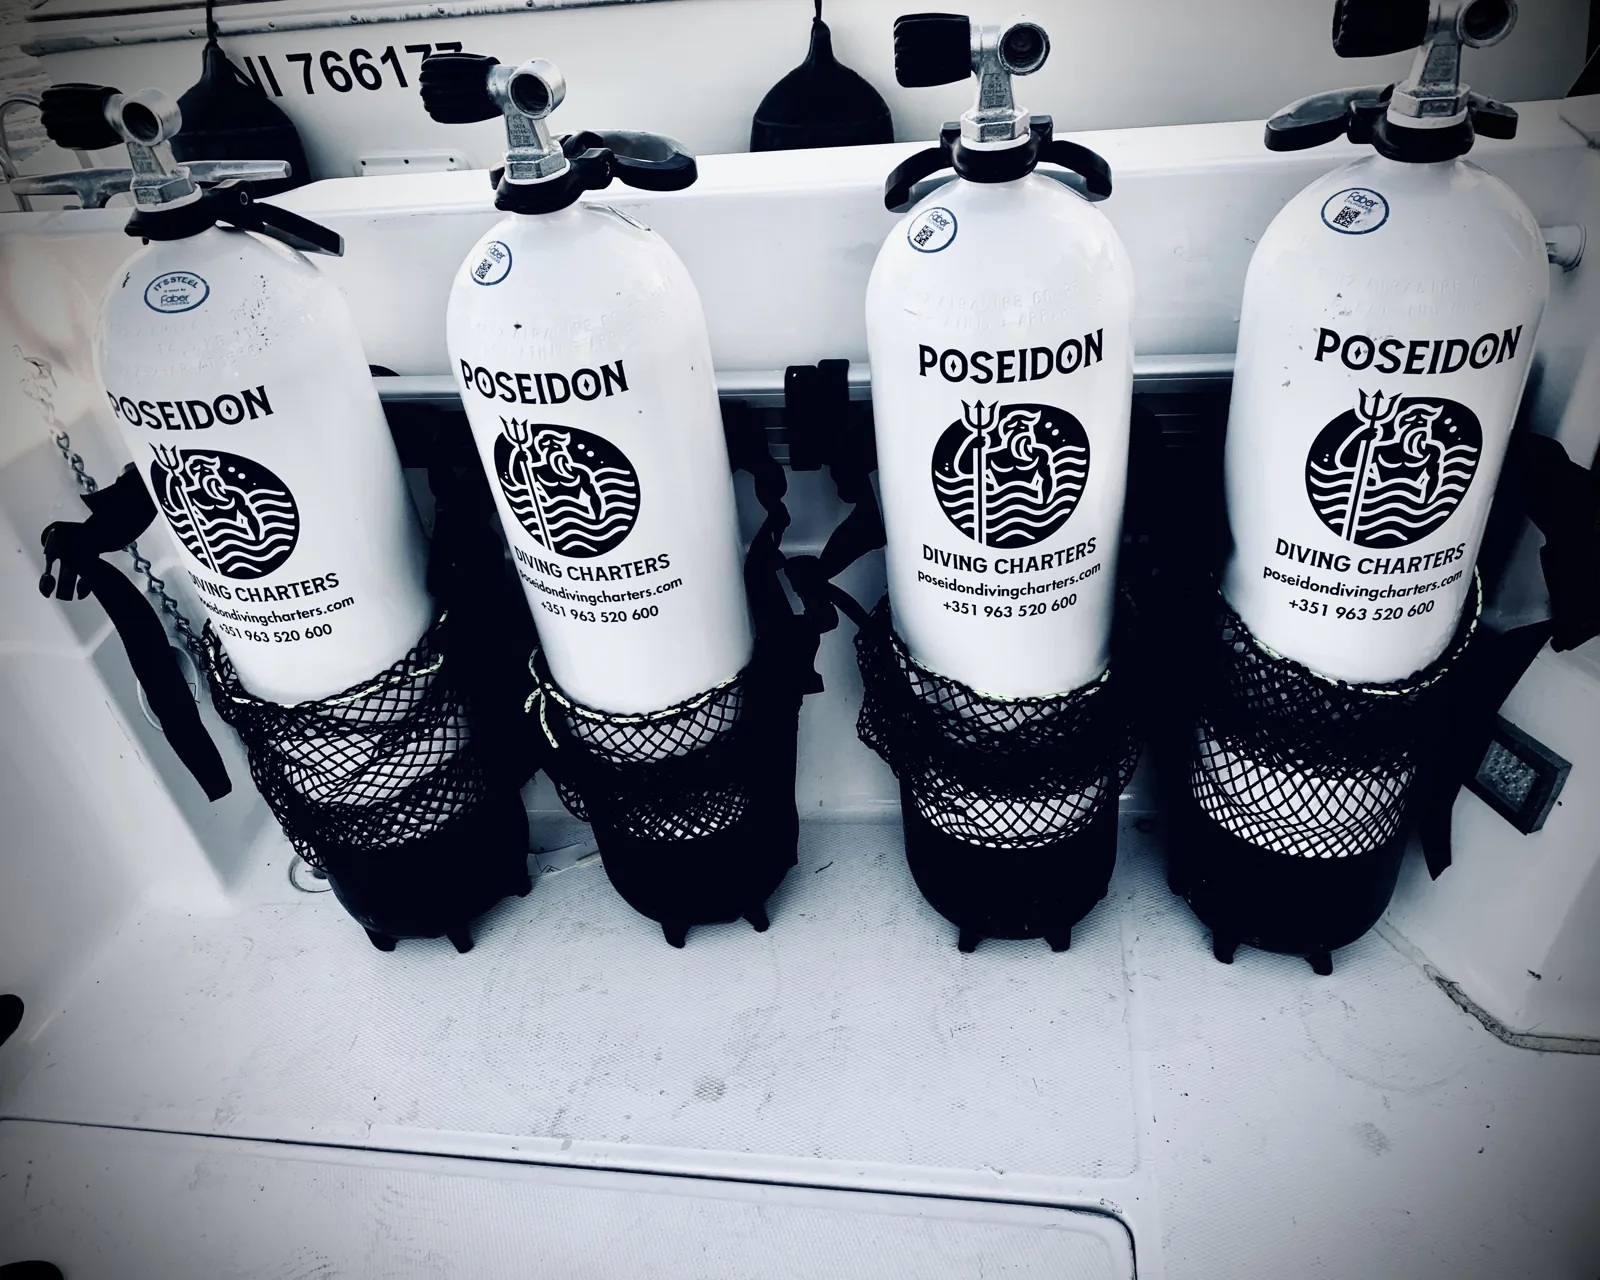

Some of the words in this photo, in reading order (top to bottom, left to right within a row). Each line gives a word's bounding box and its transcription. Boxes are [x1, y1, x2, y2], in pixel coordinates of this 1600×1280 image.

[161, 294, 190, 304] Faber
[170, 276, 198, 289] STEEL
[918, 328, 1104, 384] POSEIDON
[1314, 325, 1523, 375] POSEIDON
[460, 358, 629, 405] POSEIDON
[106, 385, 274, 431] POSEIDON
[514, 545, 562, 578] DIVING
[567, 553, 671, 582] CHARTERS
[923, 543, 988, 574] DIVING
[994, 536, 1097, 574] CHARTERS
[1275, 537, 1351, 573] DIVING
[1357, 543, 1466, 575] CHARTERS
[234, 572, 340, 603] CHARTERS
[918, 562, 1101, 600] poseidondivingcharters.com
[1263, 565, 1463, 601] poseidondivingcharters.com
[541, 601, 566, 617] +351
[570, 609, 596, 623] 963
[600, 610, 627, 623] 520
[632, 605, 659, 621] 600
[943, 600, 977, 616] +351
[983, 605, 1013, 618] 963
[1018, 603, 1047, 617] 520
[1051, 593, 1077, 612] 600
[1289, 599, 1328, 616] +351
[1335, 606, 1367, 620] 963
[1372, 607, 1403, 621] 520
[1407, 600, 1435, 618] 600
[219, 623, 242, 639] +351
[244, 630, 270, 643] 963
[274, 629, 301, 643] 520
[304, 623, 332, 640] 600
